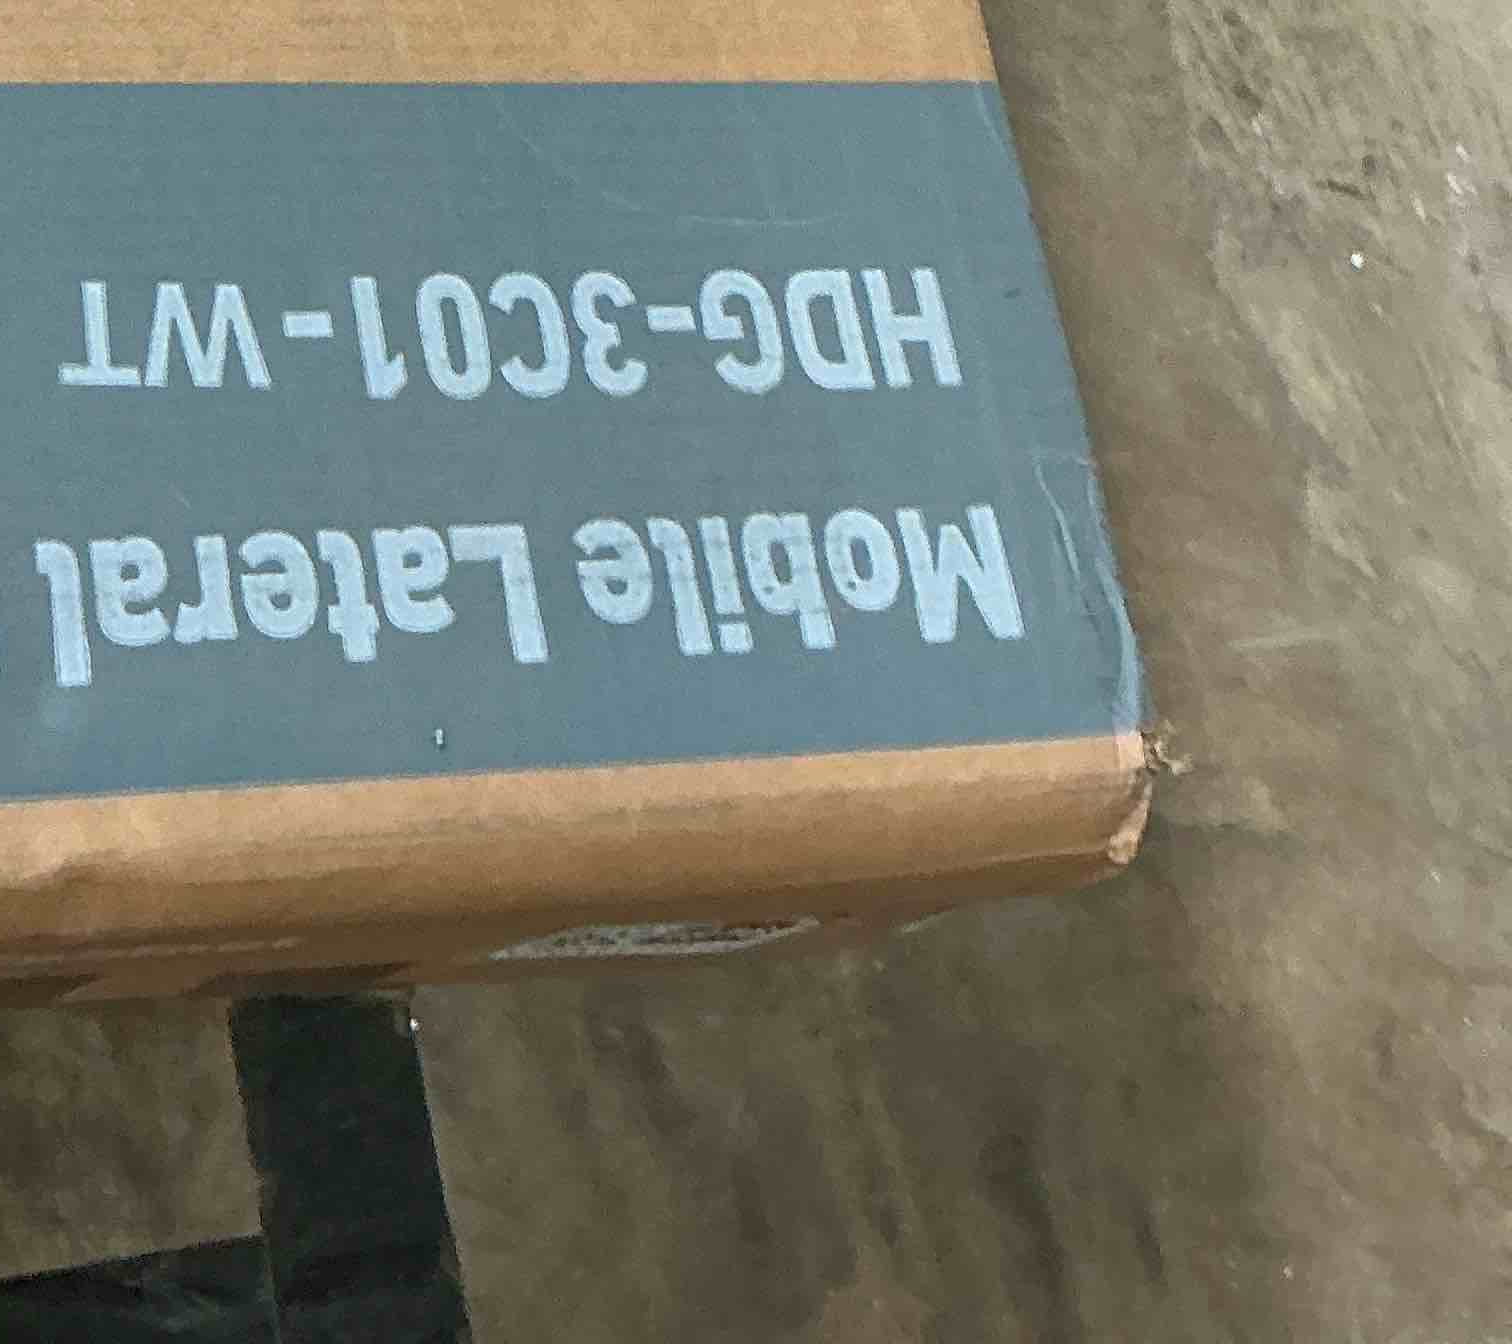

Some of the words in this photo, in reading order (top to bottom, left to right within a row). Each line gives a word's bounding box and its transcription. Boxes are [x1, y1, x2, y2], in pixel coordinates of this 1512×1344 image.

[56, 267, 963, 401] HDG-3C01-WT
[34, 521, 549, 688] Lateral
[573, 503, 1026, 657] Mobile
